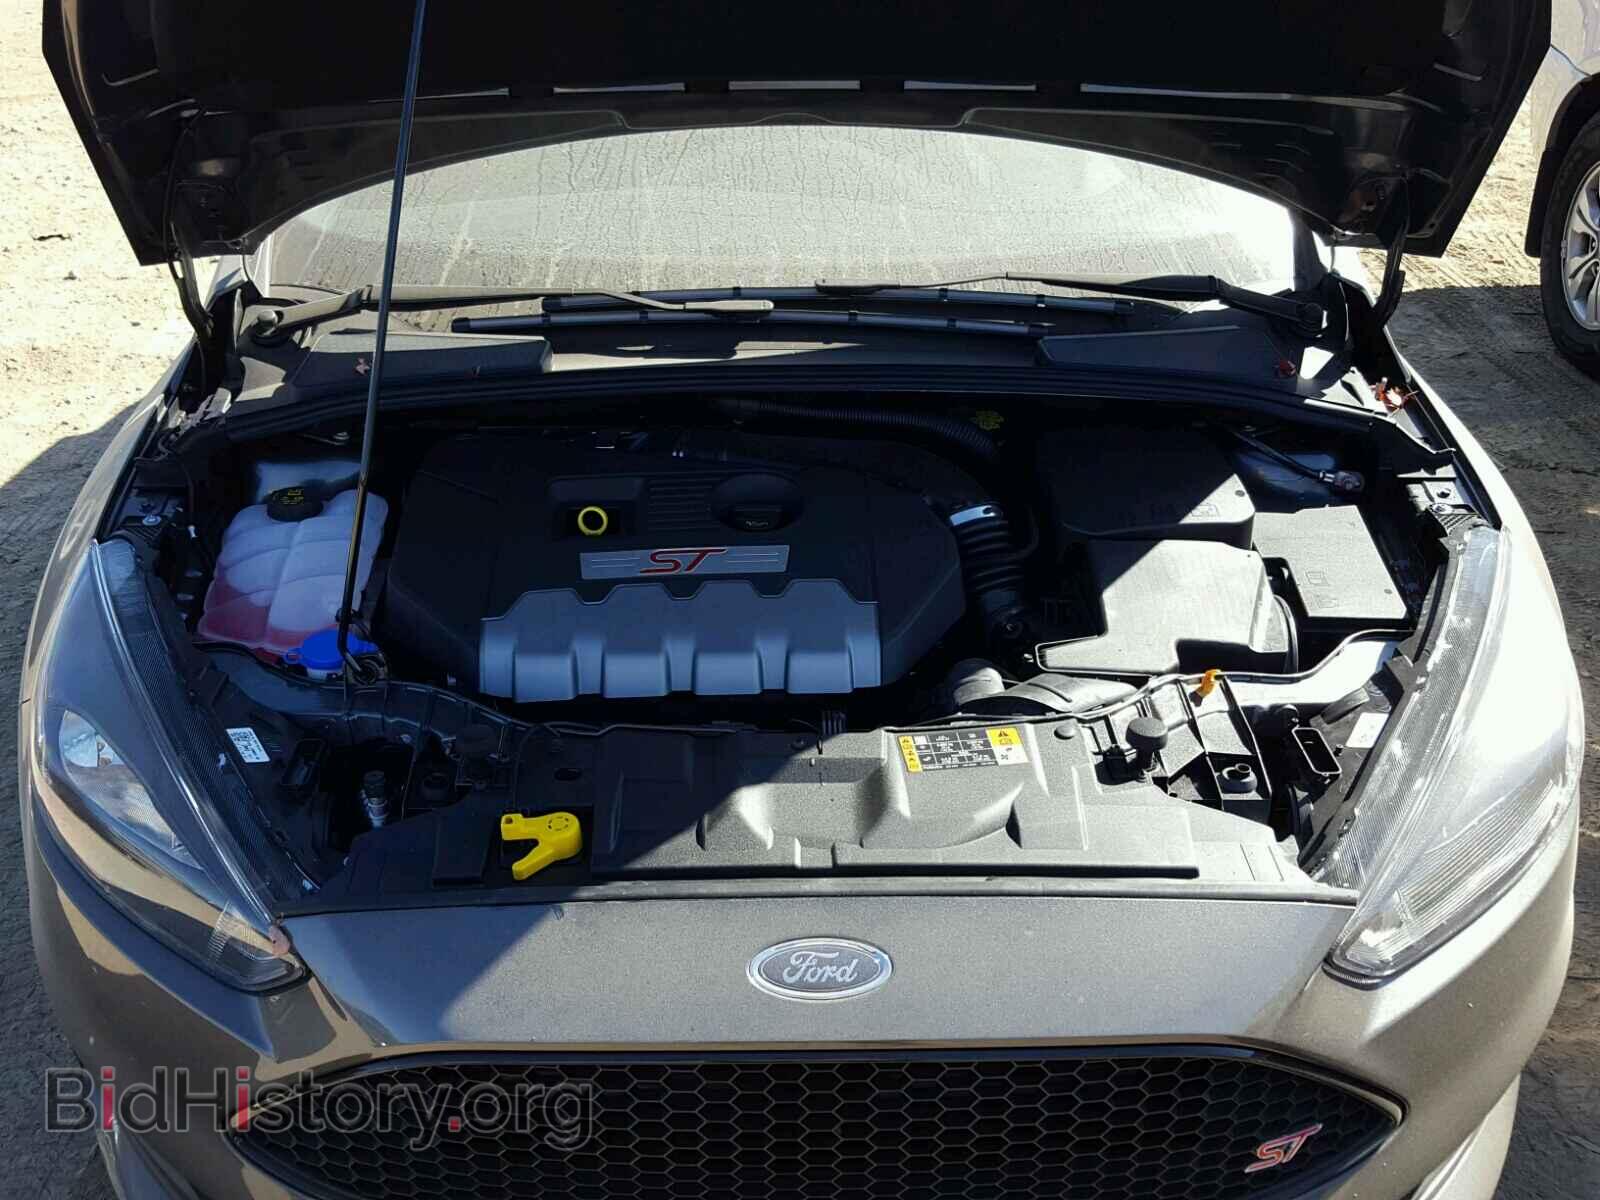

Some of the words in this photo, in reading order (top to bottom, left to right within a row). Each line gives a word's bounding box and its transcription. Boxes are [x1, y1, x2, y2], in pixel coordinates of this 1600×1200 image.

[640, 546, 728, 575] ST
[782, 950, 859, 984] Ford
[1244, 1123, 1324, 1174] ST
